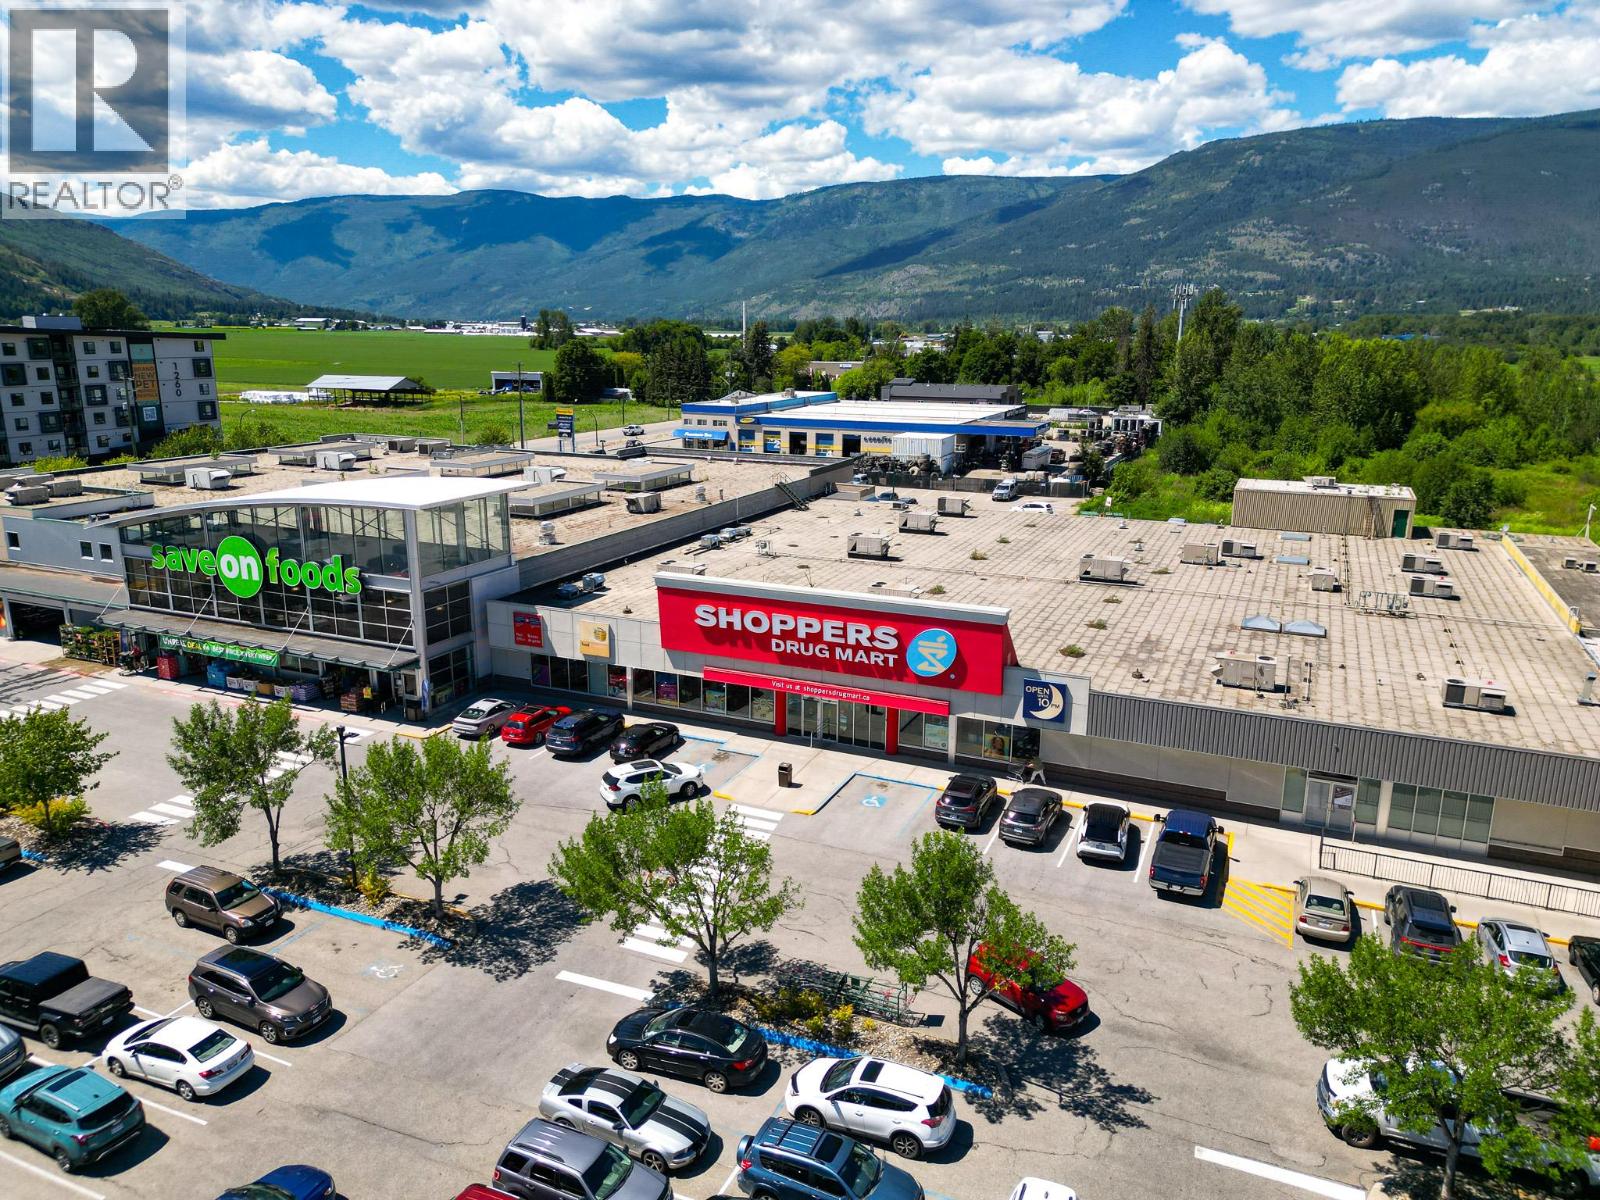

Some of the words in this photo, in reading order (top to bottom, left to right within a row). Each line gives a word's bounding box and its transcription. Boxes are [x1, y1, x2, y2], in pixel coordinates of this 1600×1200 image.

[151, 544, 217, 576] save
[220, 553, 260, 581] on
[265, 547, 362, 595] foods
[694, 604, 899, 650] SHOPPERS
[771, 638, 830, 659] DRUG
[835, 646, 898, 668] MART
[771, 680, 784, 688] Visit
[803, 685, 870, 701] shoppersdrugmart.ca
[1025, 686, 1050, 694] OPEN
[1038, 697, 1050, 707] 10
